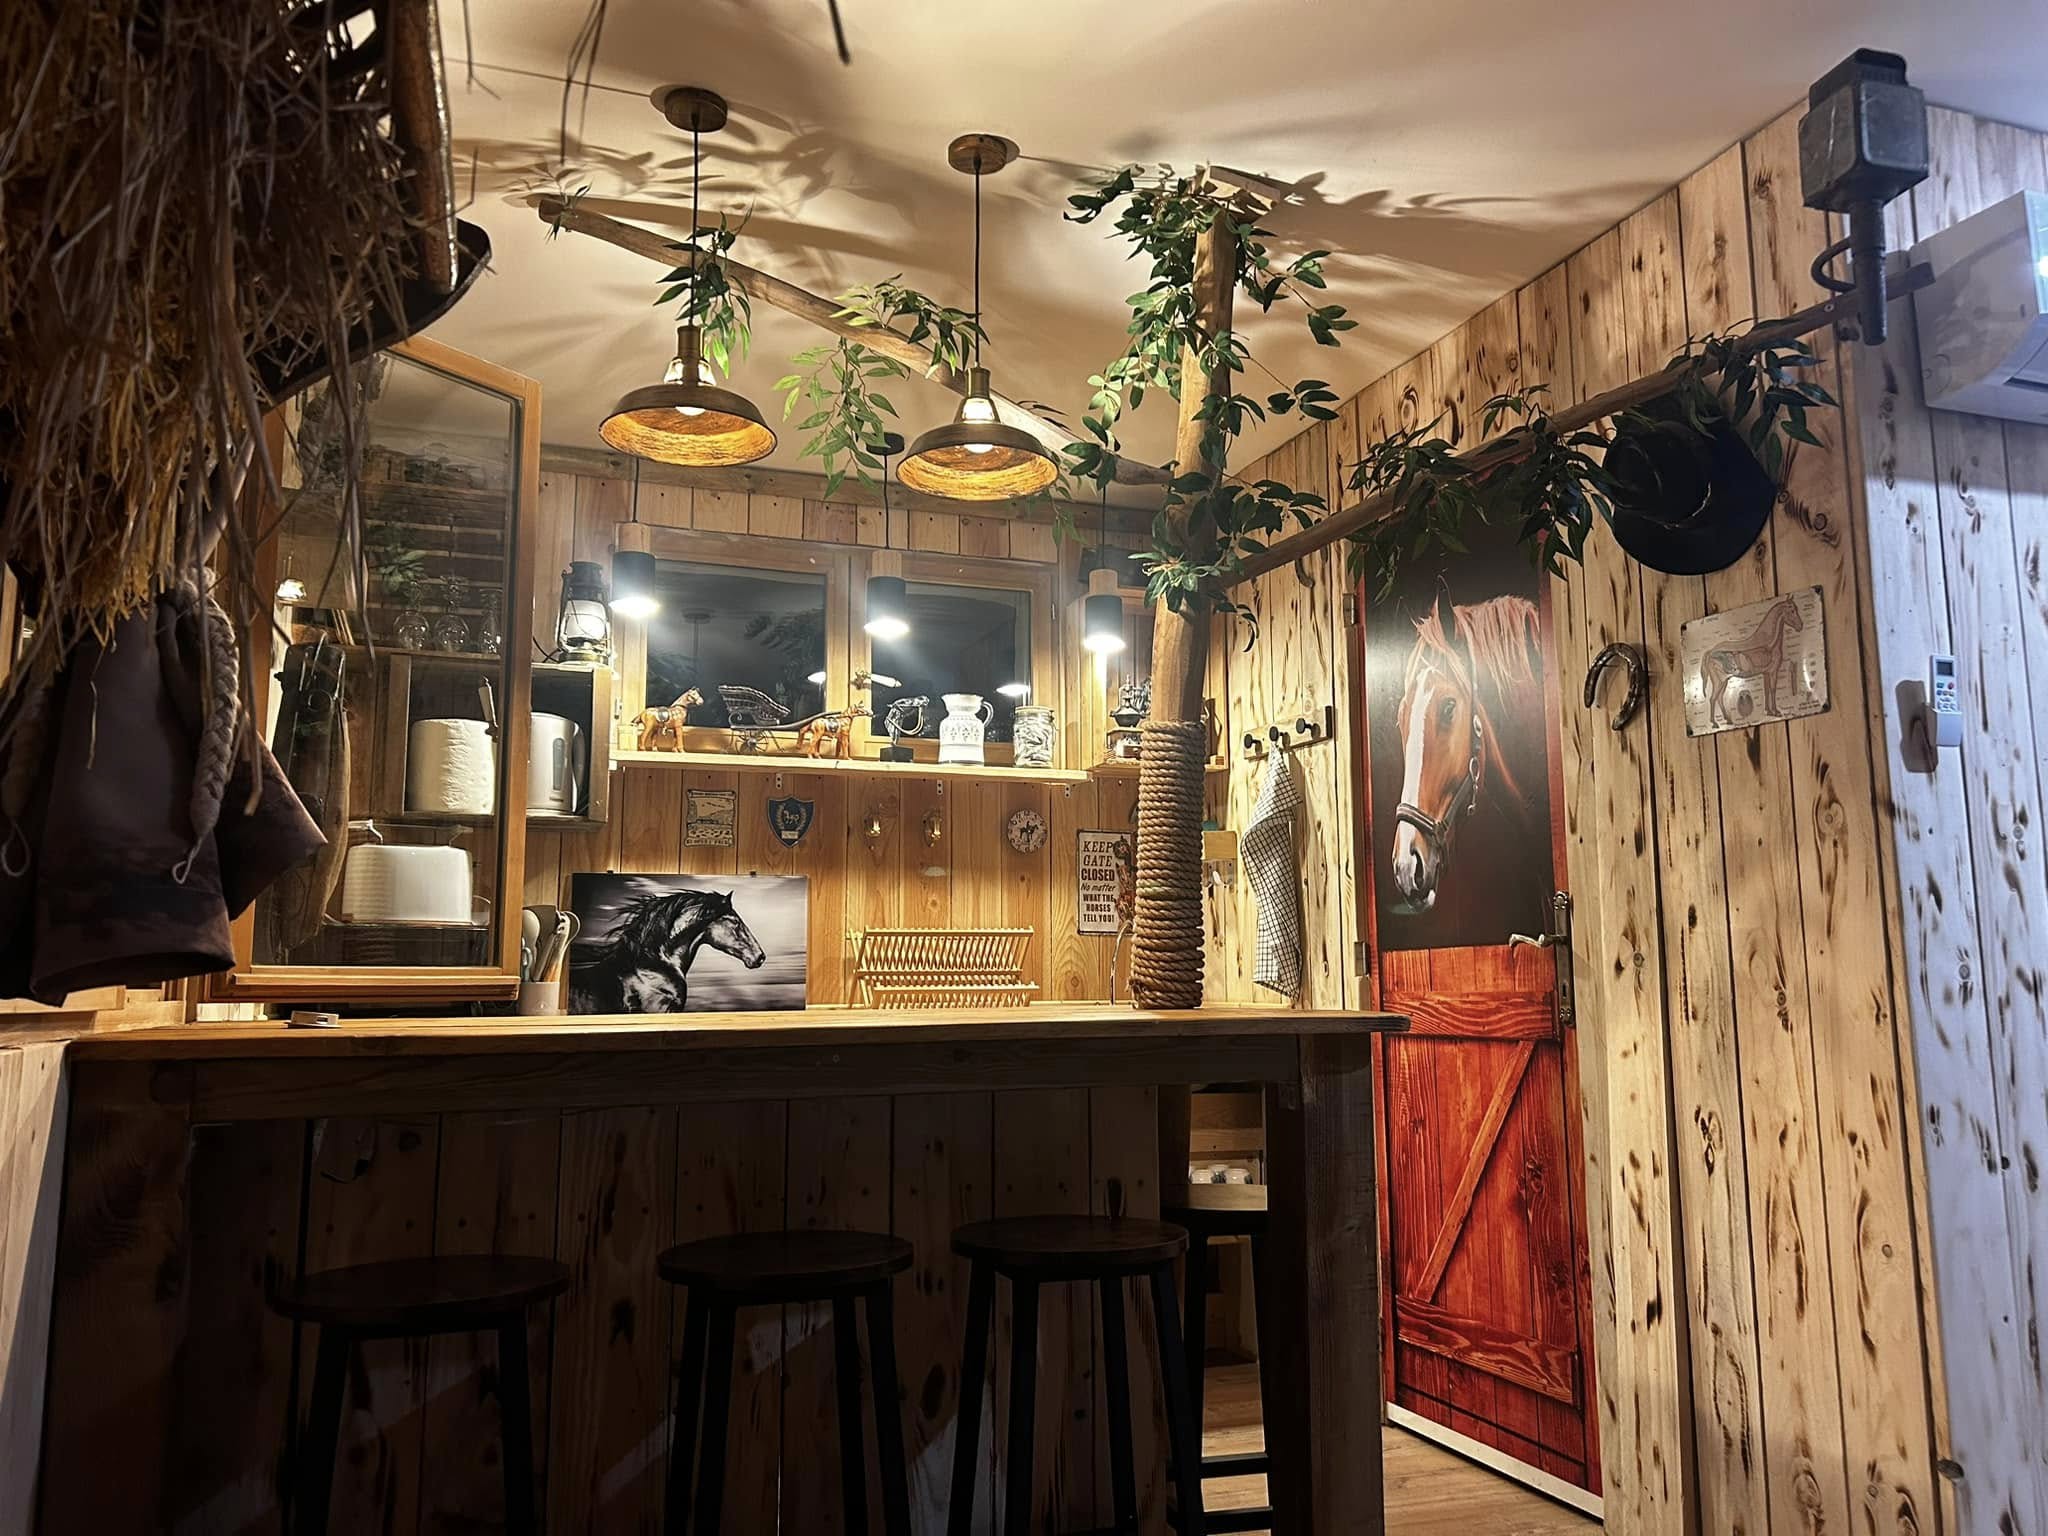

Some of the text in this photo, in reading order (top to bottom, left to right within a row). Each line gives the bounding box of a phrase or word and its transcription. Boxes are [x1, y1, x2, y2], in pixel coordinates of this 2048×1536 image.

[1083, 841, 1113, 853] KEEP
[1083, 855, 1113, 867] GATE
[1081, 868, 1115, 881] CLOSED
[1081, 882, 1116, 892] No matter
[1083, 894, 1114, 902] WHAT THE
[1086, 904, 1111, 912] HORSES
[1083, 914, 1097, 922] TELL
